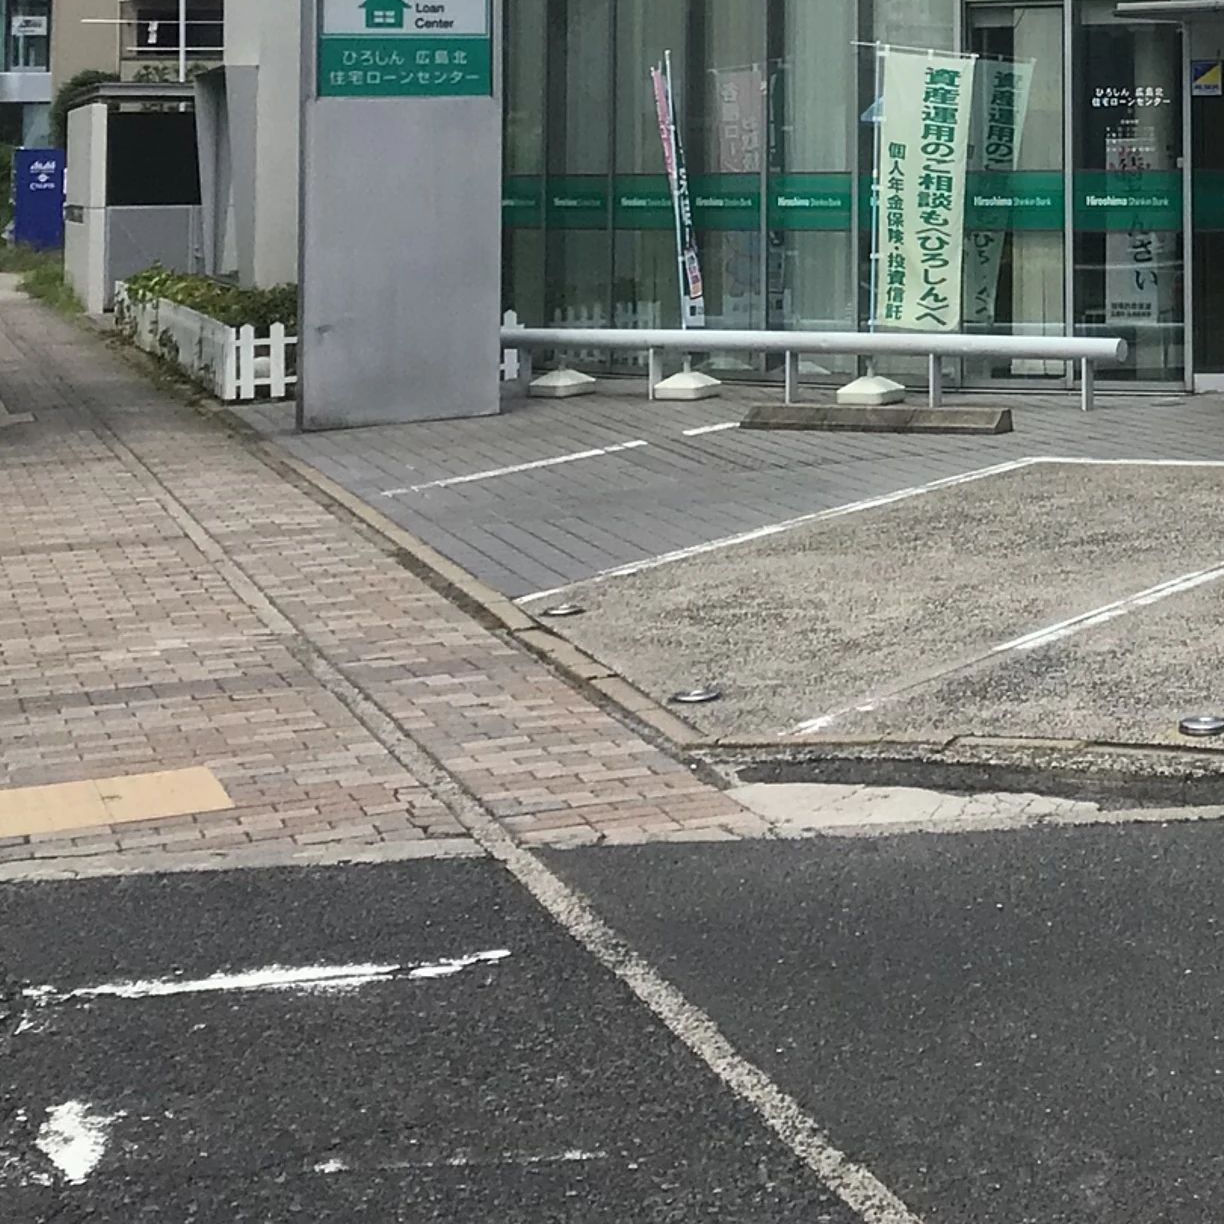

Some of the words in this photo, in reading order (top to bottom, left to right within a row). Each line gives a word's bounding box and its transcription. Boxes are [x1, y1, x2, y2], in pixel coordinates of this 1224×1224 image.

[415, 3, 445, 13] Loan
[415, 18, 454, 29] Center
[342, 50, 405, 66] ひろしん
[415, 50, 468, 65] 広島北
[330, 71, 480, 85] 住宅ローンセンター
